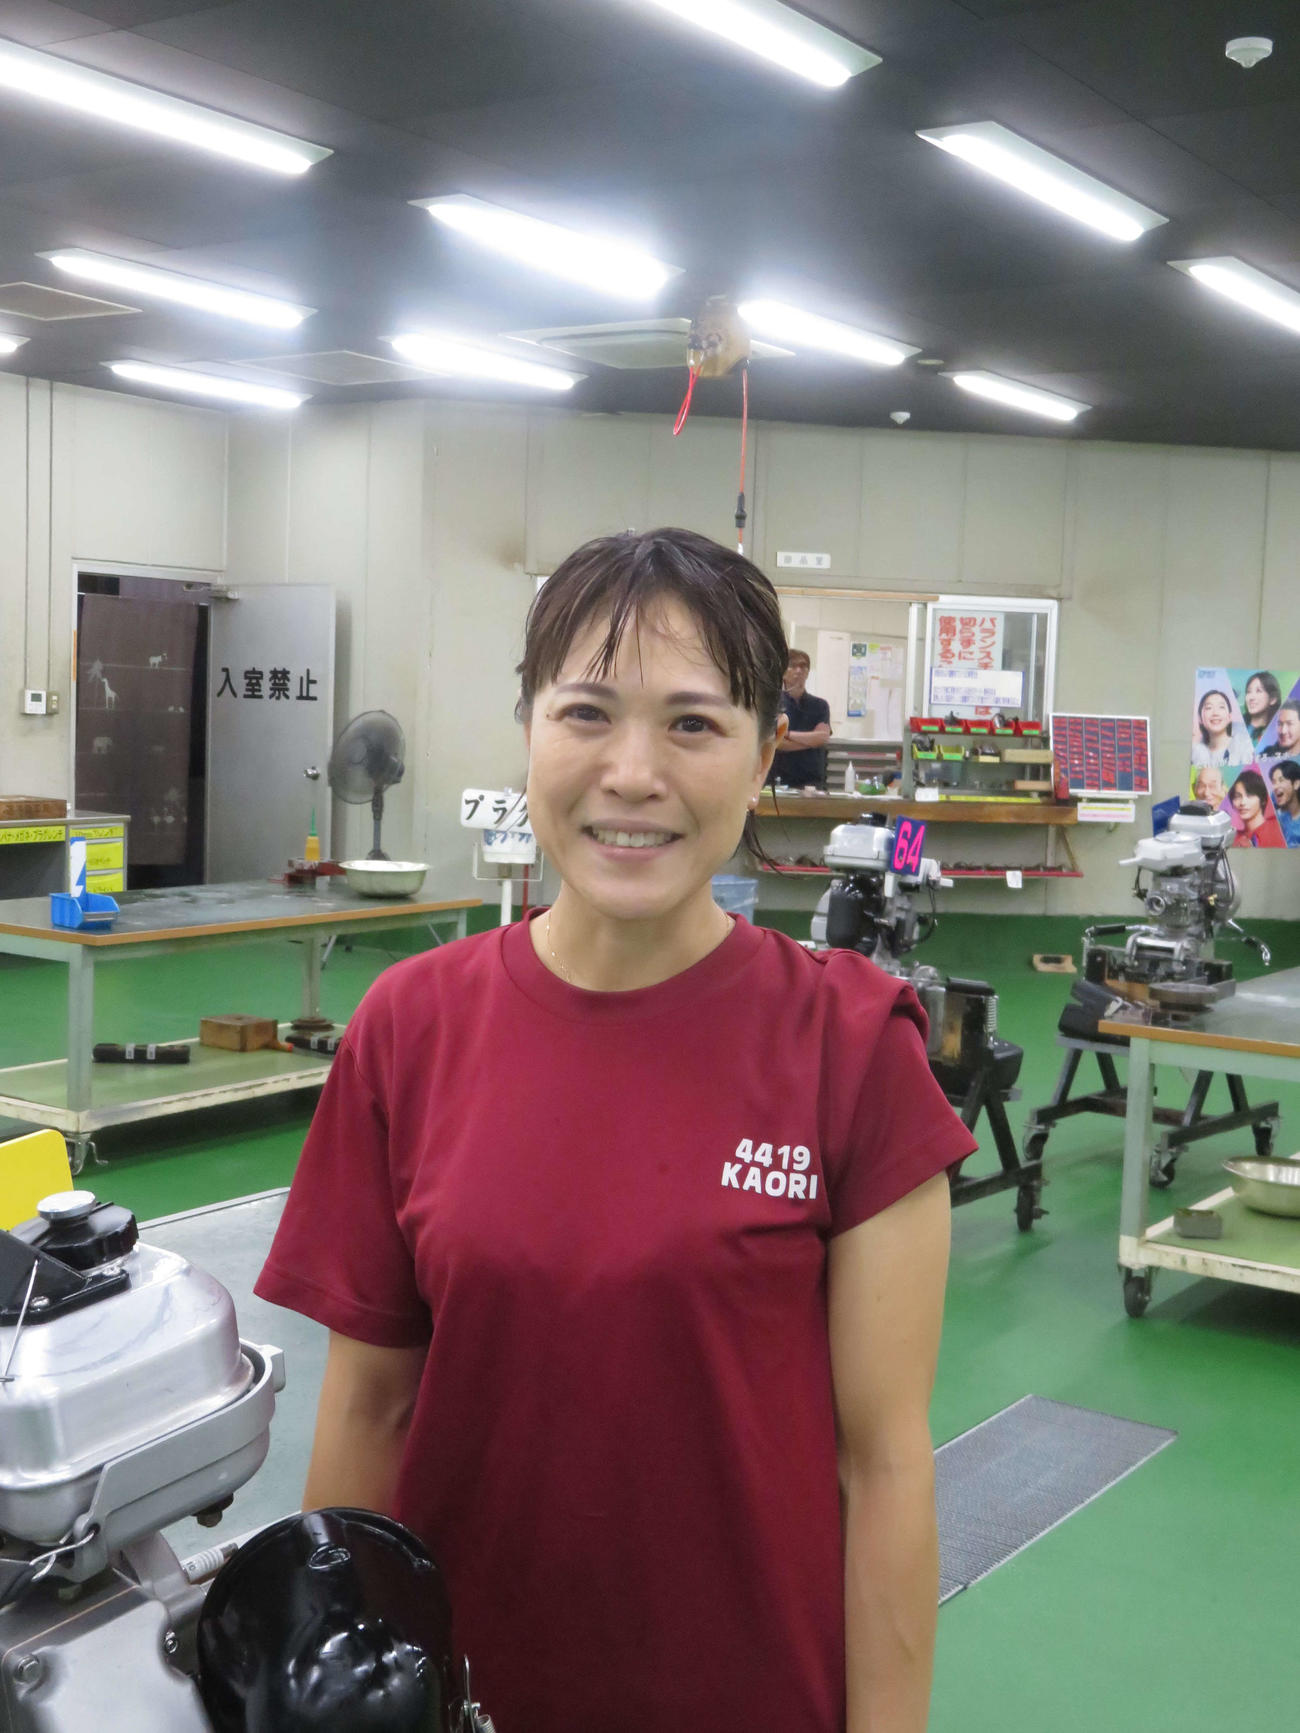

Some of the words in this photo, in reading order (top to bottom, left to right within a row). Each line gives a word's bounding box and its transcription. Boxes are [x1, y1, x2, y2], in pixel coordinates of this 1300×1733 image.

[216, 667, 318, 700] 入室禁止
[893, 821, 926, 873] 64
[735, 1138, 811, 1171] 4419
[721, 1161, 818, 1200] KAORI
